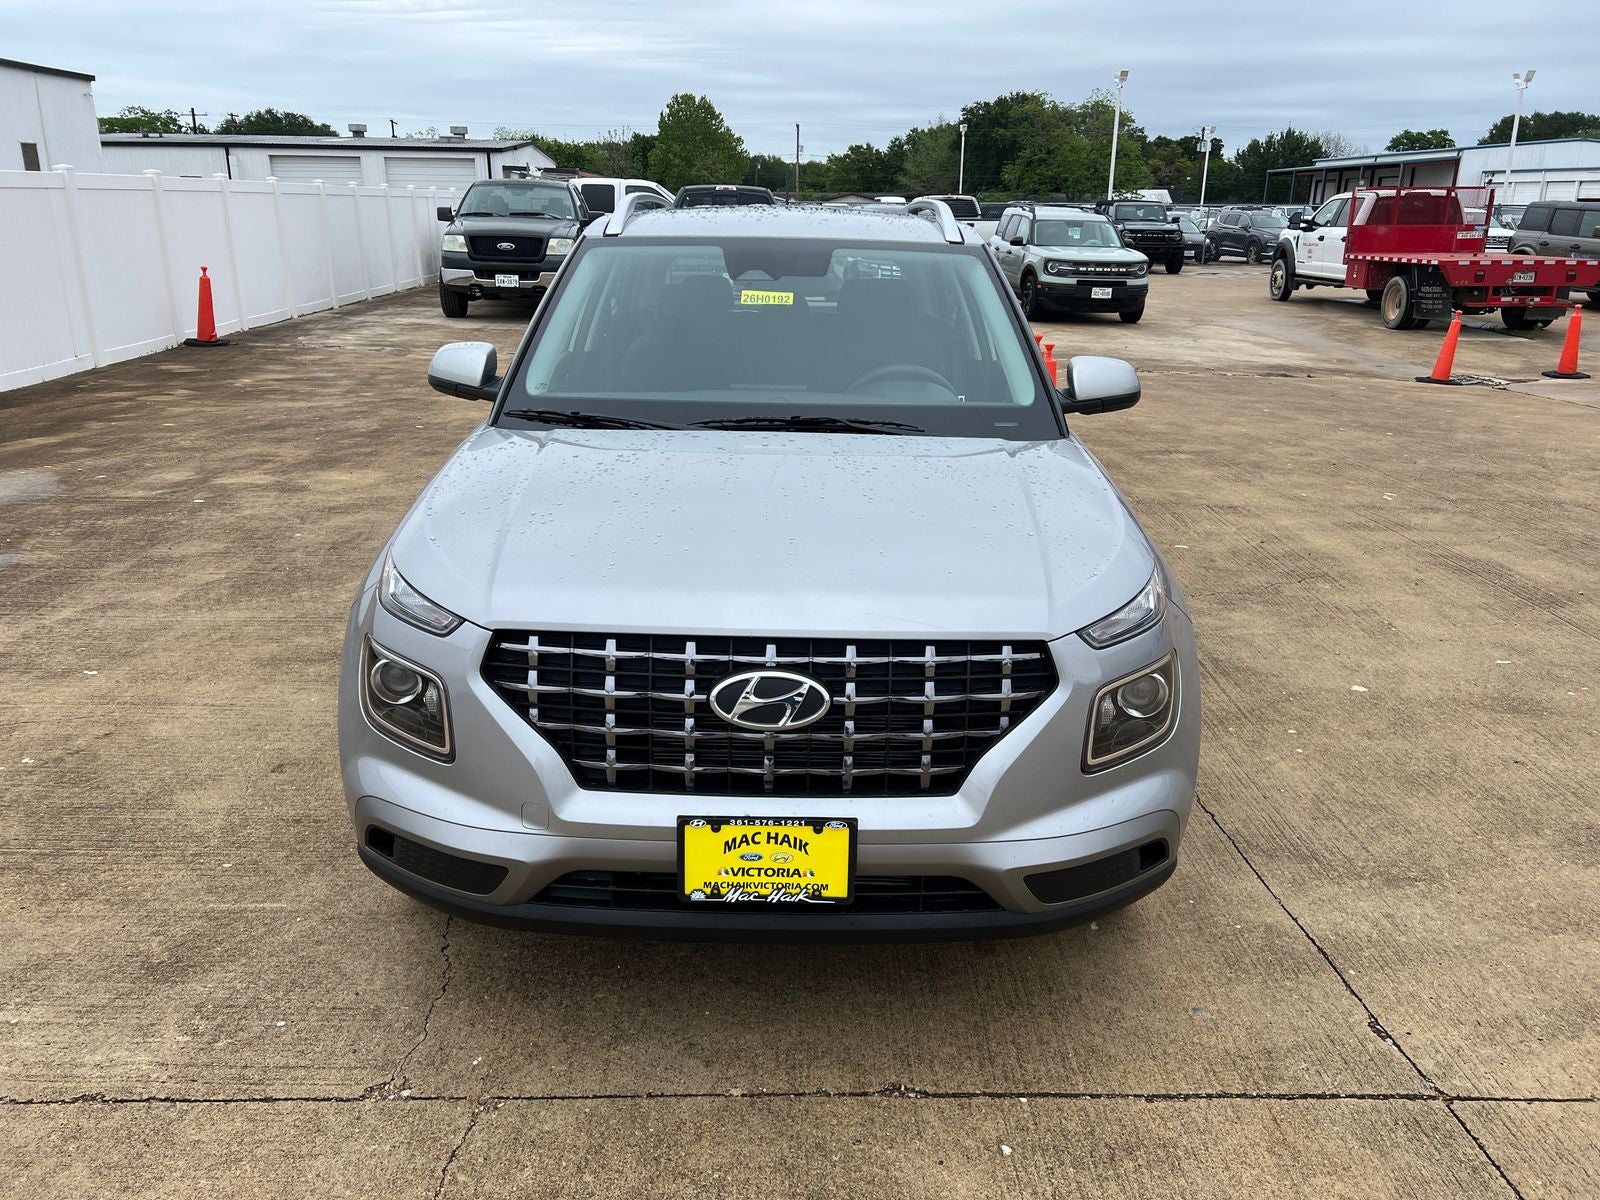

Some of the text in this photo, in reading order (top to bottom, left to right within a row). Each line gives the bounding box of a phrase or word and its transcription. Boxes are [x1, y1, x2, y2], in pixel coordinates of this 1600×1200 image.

[743, 294, 790, 303] 26H0192
[723, 831, 809, 856] MAC HAIK
[730, 867, 802, 878] VICTORIA
[723, 887, 812, 903] Mac Haik
